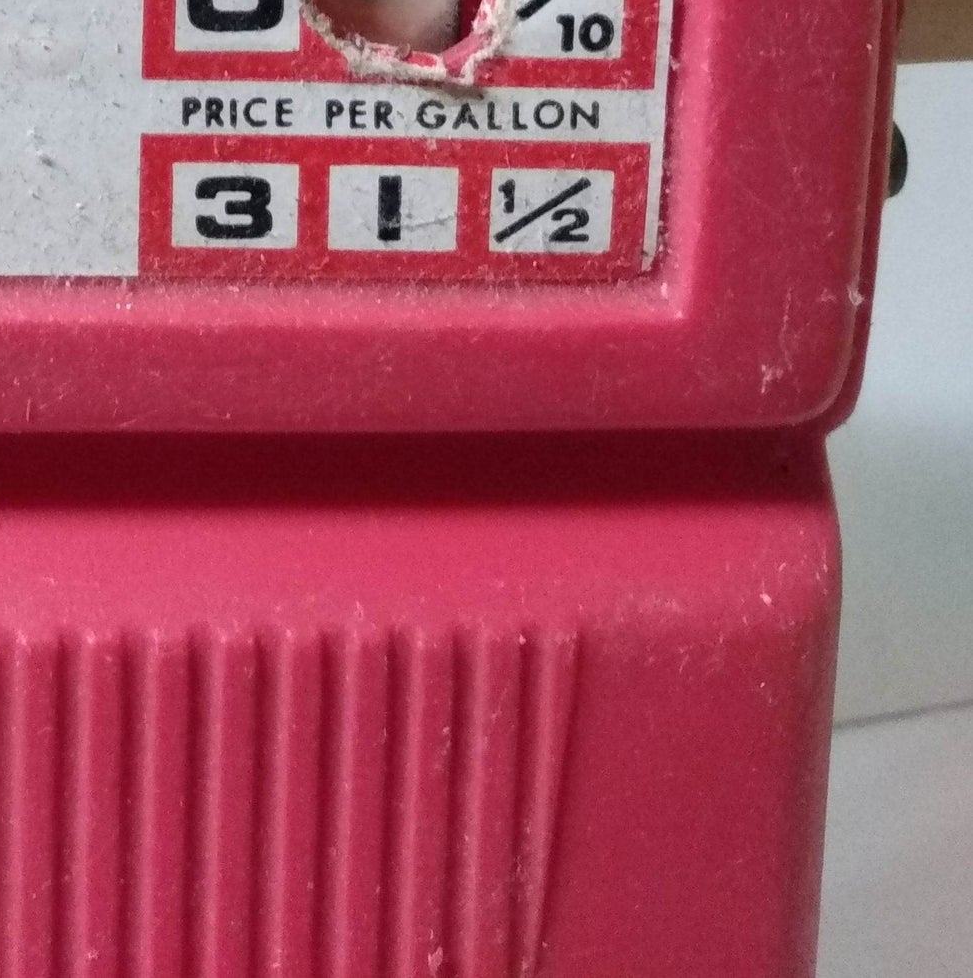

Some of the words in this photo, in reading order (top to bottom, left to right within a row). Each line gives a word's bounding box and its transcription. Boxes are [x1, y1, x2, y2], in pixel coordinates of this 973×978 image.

[182, 97, 294, 128] PRICE
[325, 100, 395, 130] PER
[416, 100, 600, 131] GALLON
